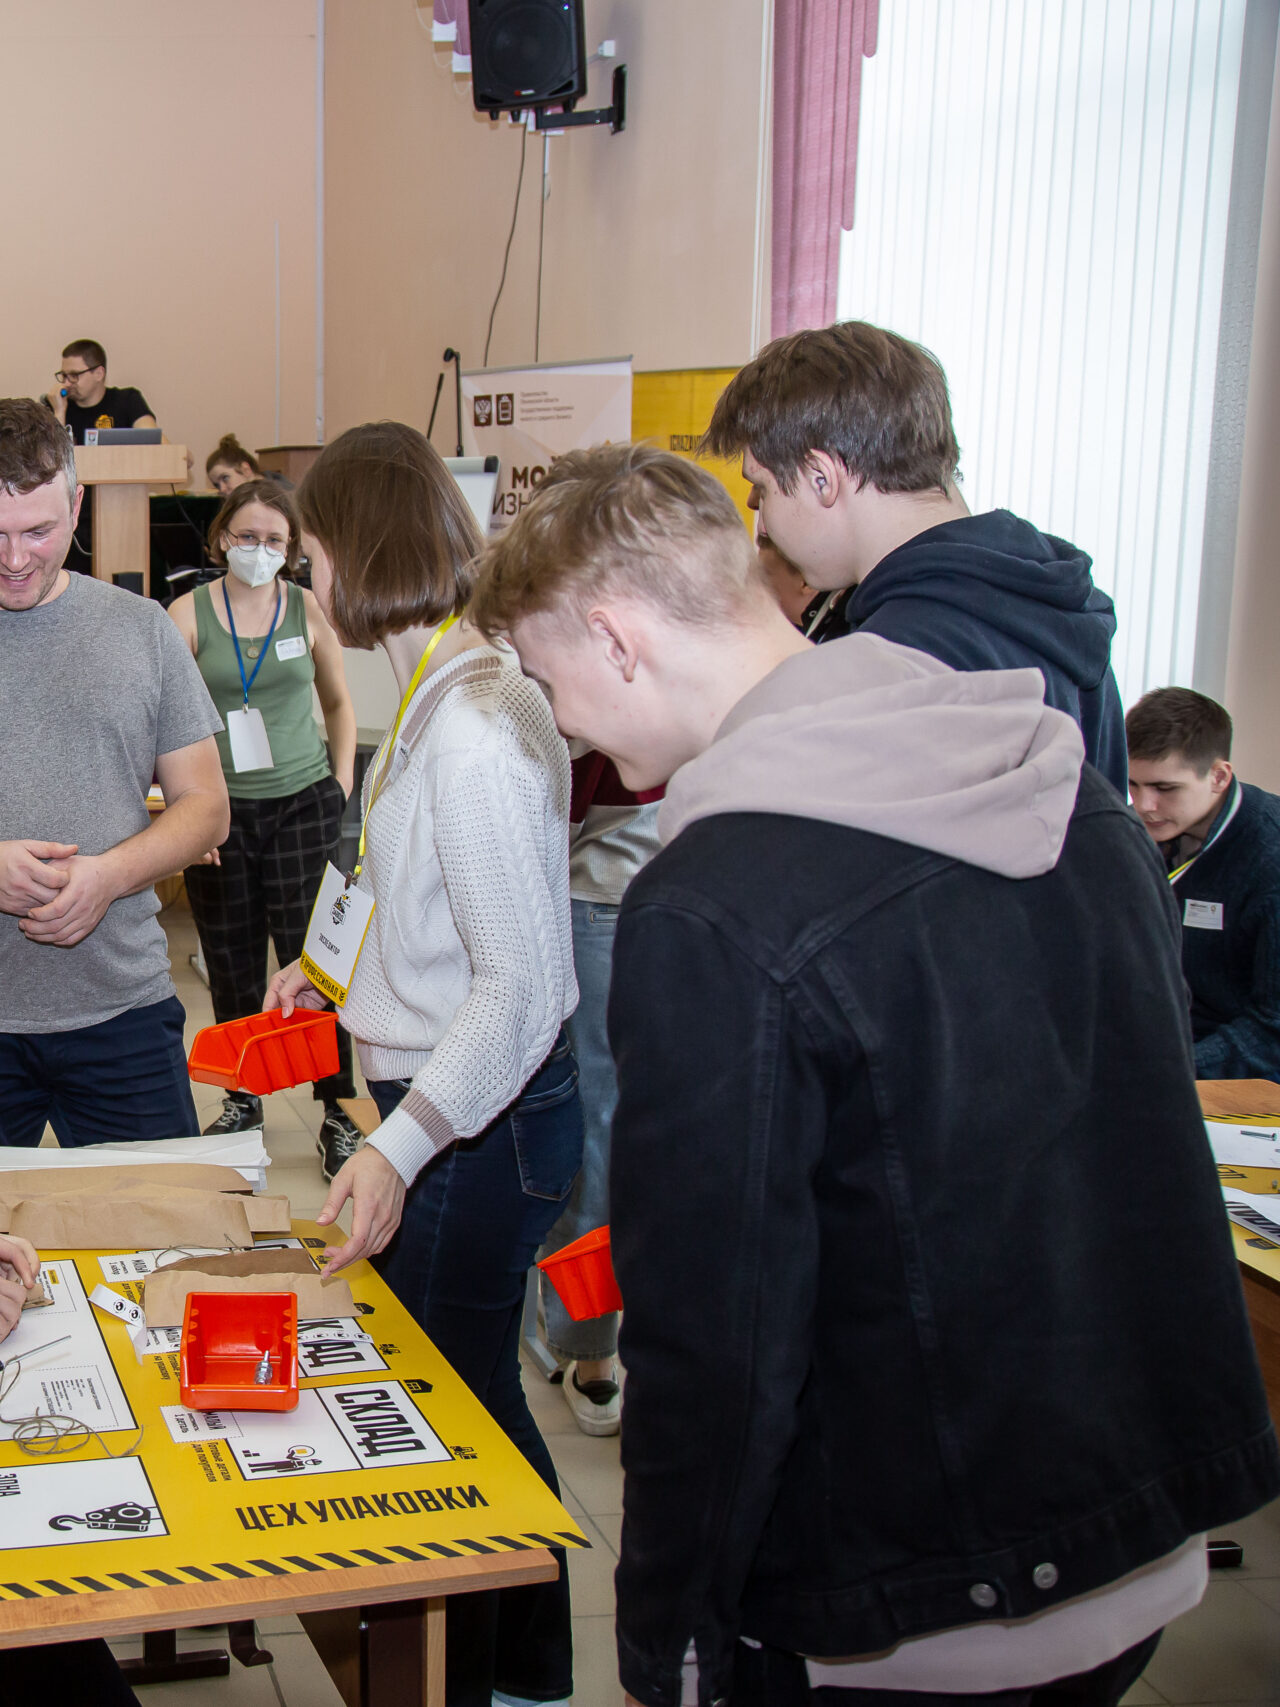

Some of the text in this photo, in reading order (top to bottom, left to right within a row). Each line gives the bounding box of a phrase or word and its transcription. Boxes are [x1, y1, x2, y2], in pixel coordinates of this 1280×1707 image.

[511, 465, 554, 489] МО
[304, 960, 339, 997] ПРОФЕССИОНАЛ
[297, 1320, 366, 1368] КАД
[175, 1417, 189, 1434] деталь
[334, 1388, 427, 1458] СКЛАД
[191, 1443, 217, 1483] для покупателя
[207, 1442, 232, 1481] Готовые детали
[235, 1485, 490, 1531] ЦЕХ УПАКОВКИ
